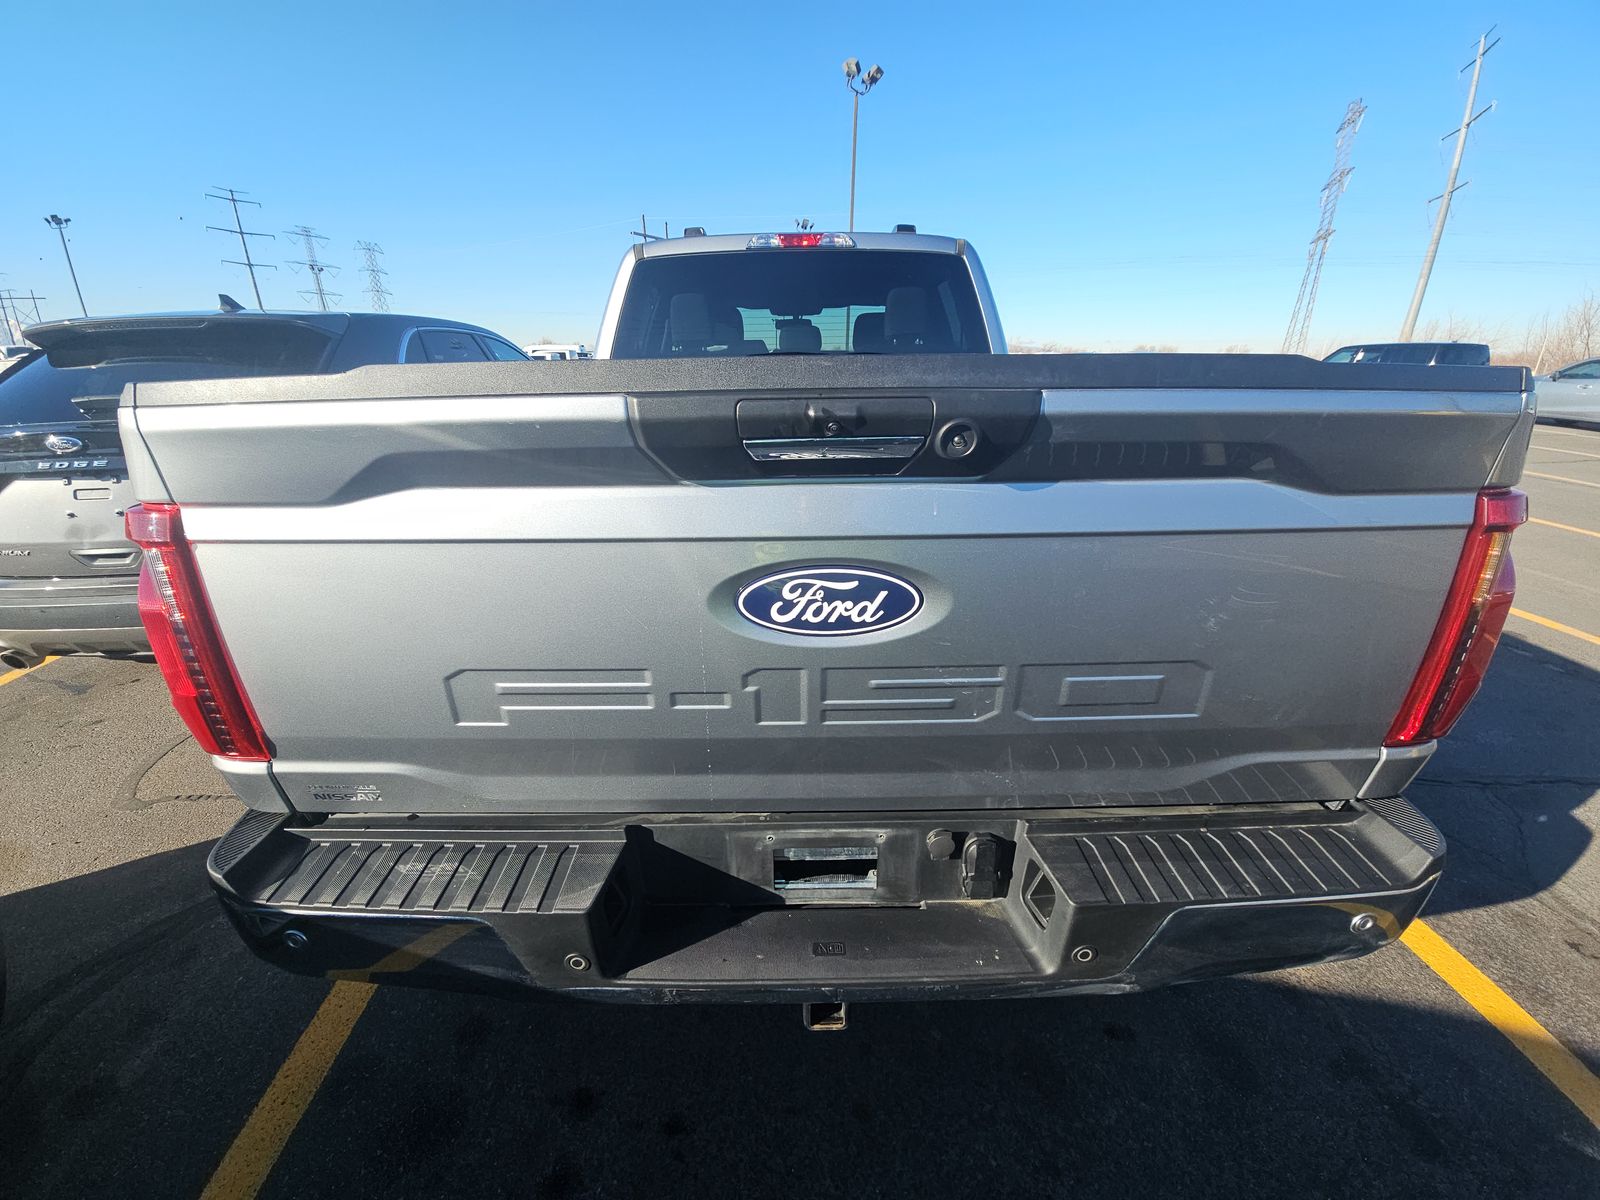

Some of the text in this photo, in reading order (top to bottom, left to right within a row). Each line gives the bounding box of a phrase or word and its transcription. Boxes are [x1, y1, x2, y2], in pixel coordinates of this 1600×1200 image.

[38, 460, 108, 470] EDGE
[770, 578, 889, 623] Ford
[443, 660, 1215, 726] F-150
[313, 793, 383, 802] NISSAN
